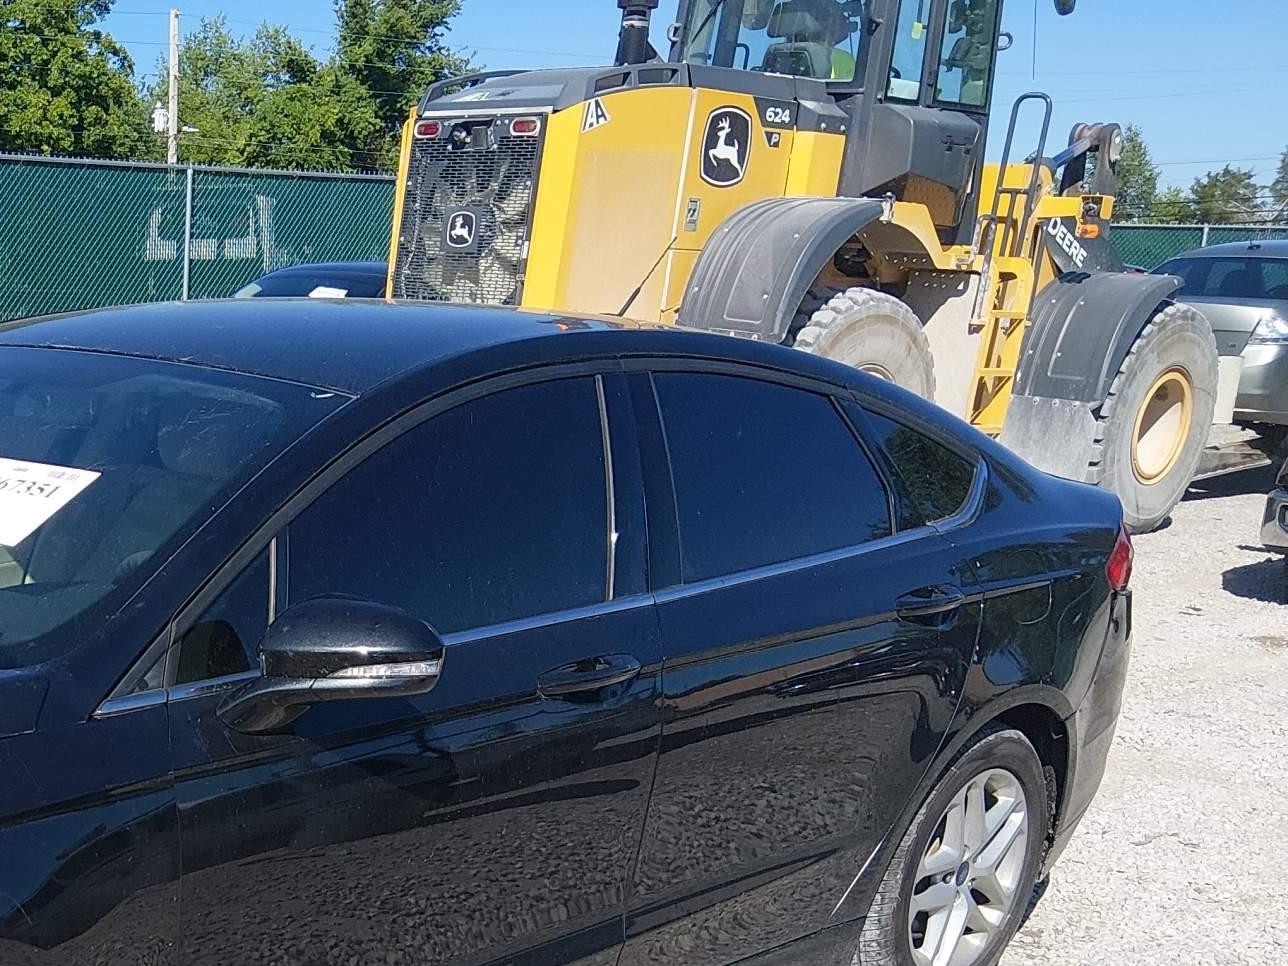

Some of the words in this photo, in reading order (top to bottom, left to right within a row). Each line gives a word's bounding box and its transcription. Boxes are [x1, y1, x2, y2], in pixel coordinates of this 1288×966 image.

[765, 106, 791, 123] 624
[770, 133, 780, 146] P
[1047, 217, 1088, 269] DEERE
